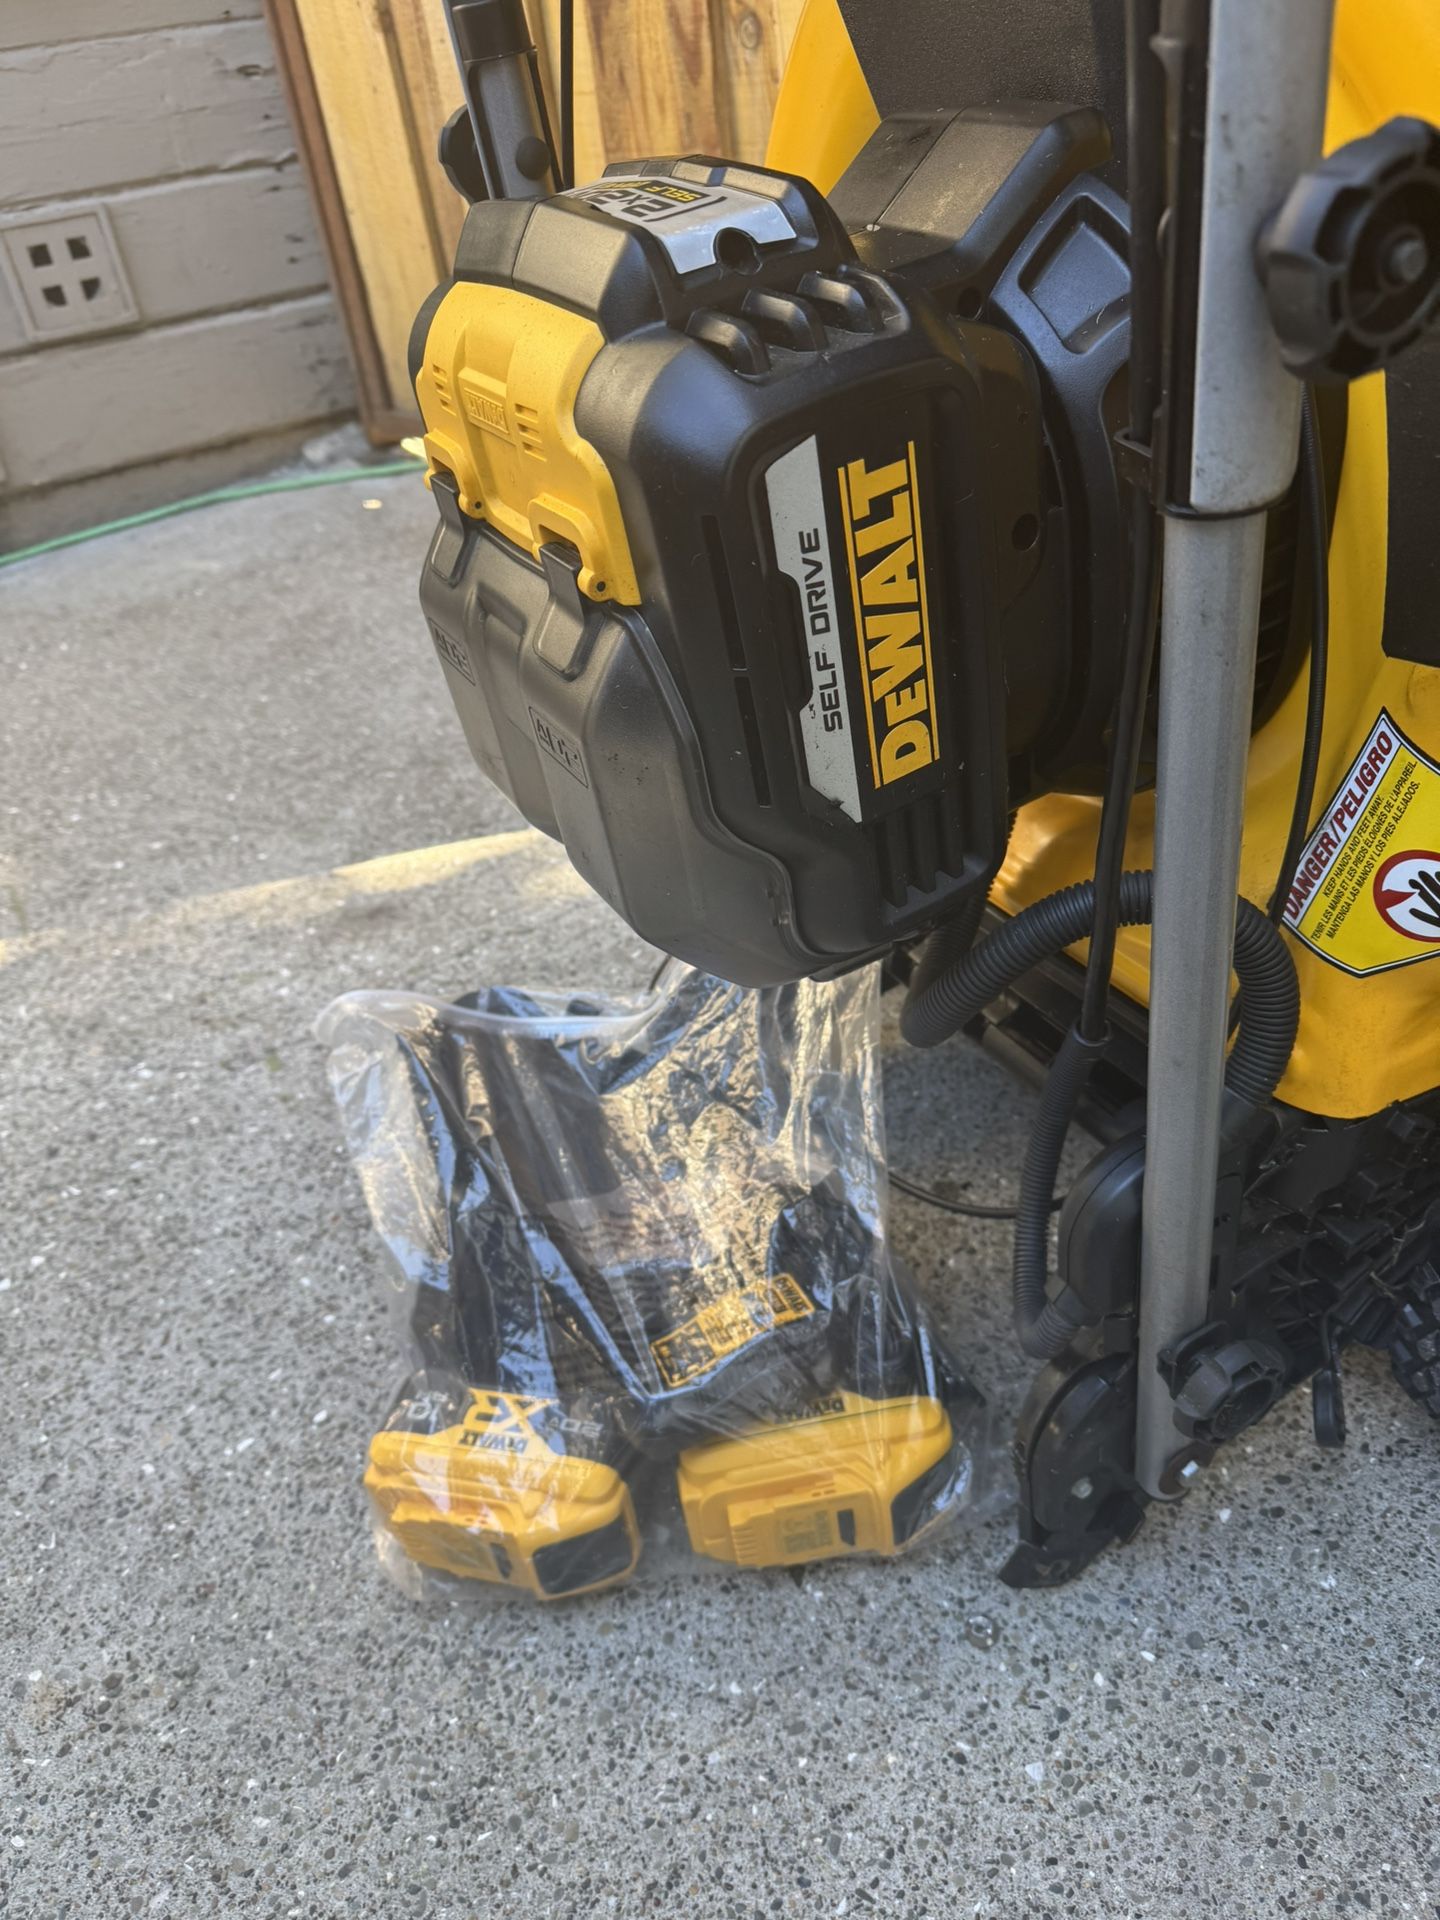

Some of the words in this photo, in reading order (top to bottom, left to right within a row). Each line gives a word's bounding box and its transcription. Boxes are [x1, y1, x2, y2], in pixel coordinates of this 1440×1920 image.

[644, 185, 703, 203] SELF
[799, 527, 832, 637] DRIVE
[846, 457, 933, 786] DEWALT
[817, 650, 844, 733] SELF
[1388, 757, 1418, 803] L'APPAREIL.
[1382, 799, 1395, 814] DE
[1390, 778, 1421, 824] ALEJADOS.
[1284, 730, 1394, 920] DANGER/PELIGRO
[1361, 810, 1389, 849] ÉLOIGNÉS
[1380, 821, 1397, 842] PIES
[1322, 876, 1338, 899] KEEP
[1333, 851, 1352, 879] HANDS
[1346, 835, 1361, 855] AND
[1356, 816, 1372, 839] FEET
[1366, 793, 1385, 820] AWAY.
[1352, 845, 1369, 869] PIEDS
[1372, 838, 1387, 858] LOS
[1368, 853, 1378, 865] Y
[1339, 878, 1350, 892] ET
[1344, 865, 1358, 882] LES
[1354, 860, 1375, 889] MANOS
[1328, 888, 1345, 912] MAINS
[1346, 885, 1361, 903] LAS
[1320, 908, 1333, 925] LES
[1325, 900, 1352, 939] MANTENGA
[1311, 920, 1326, 942] TENIR
[463, 1388, 561, 1434] XR
